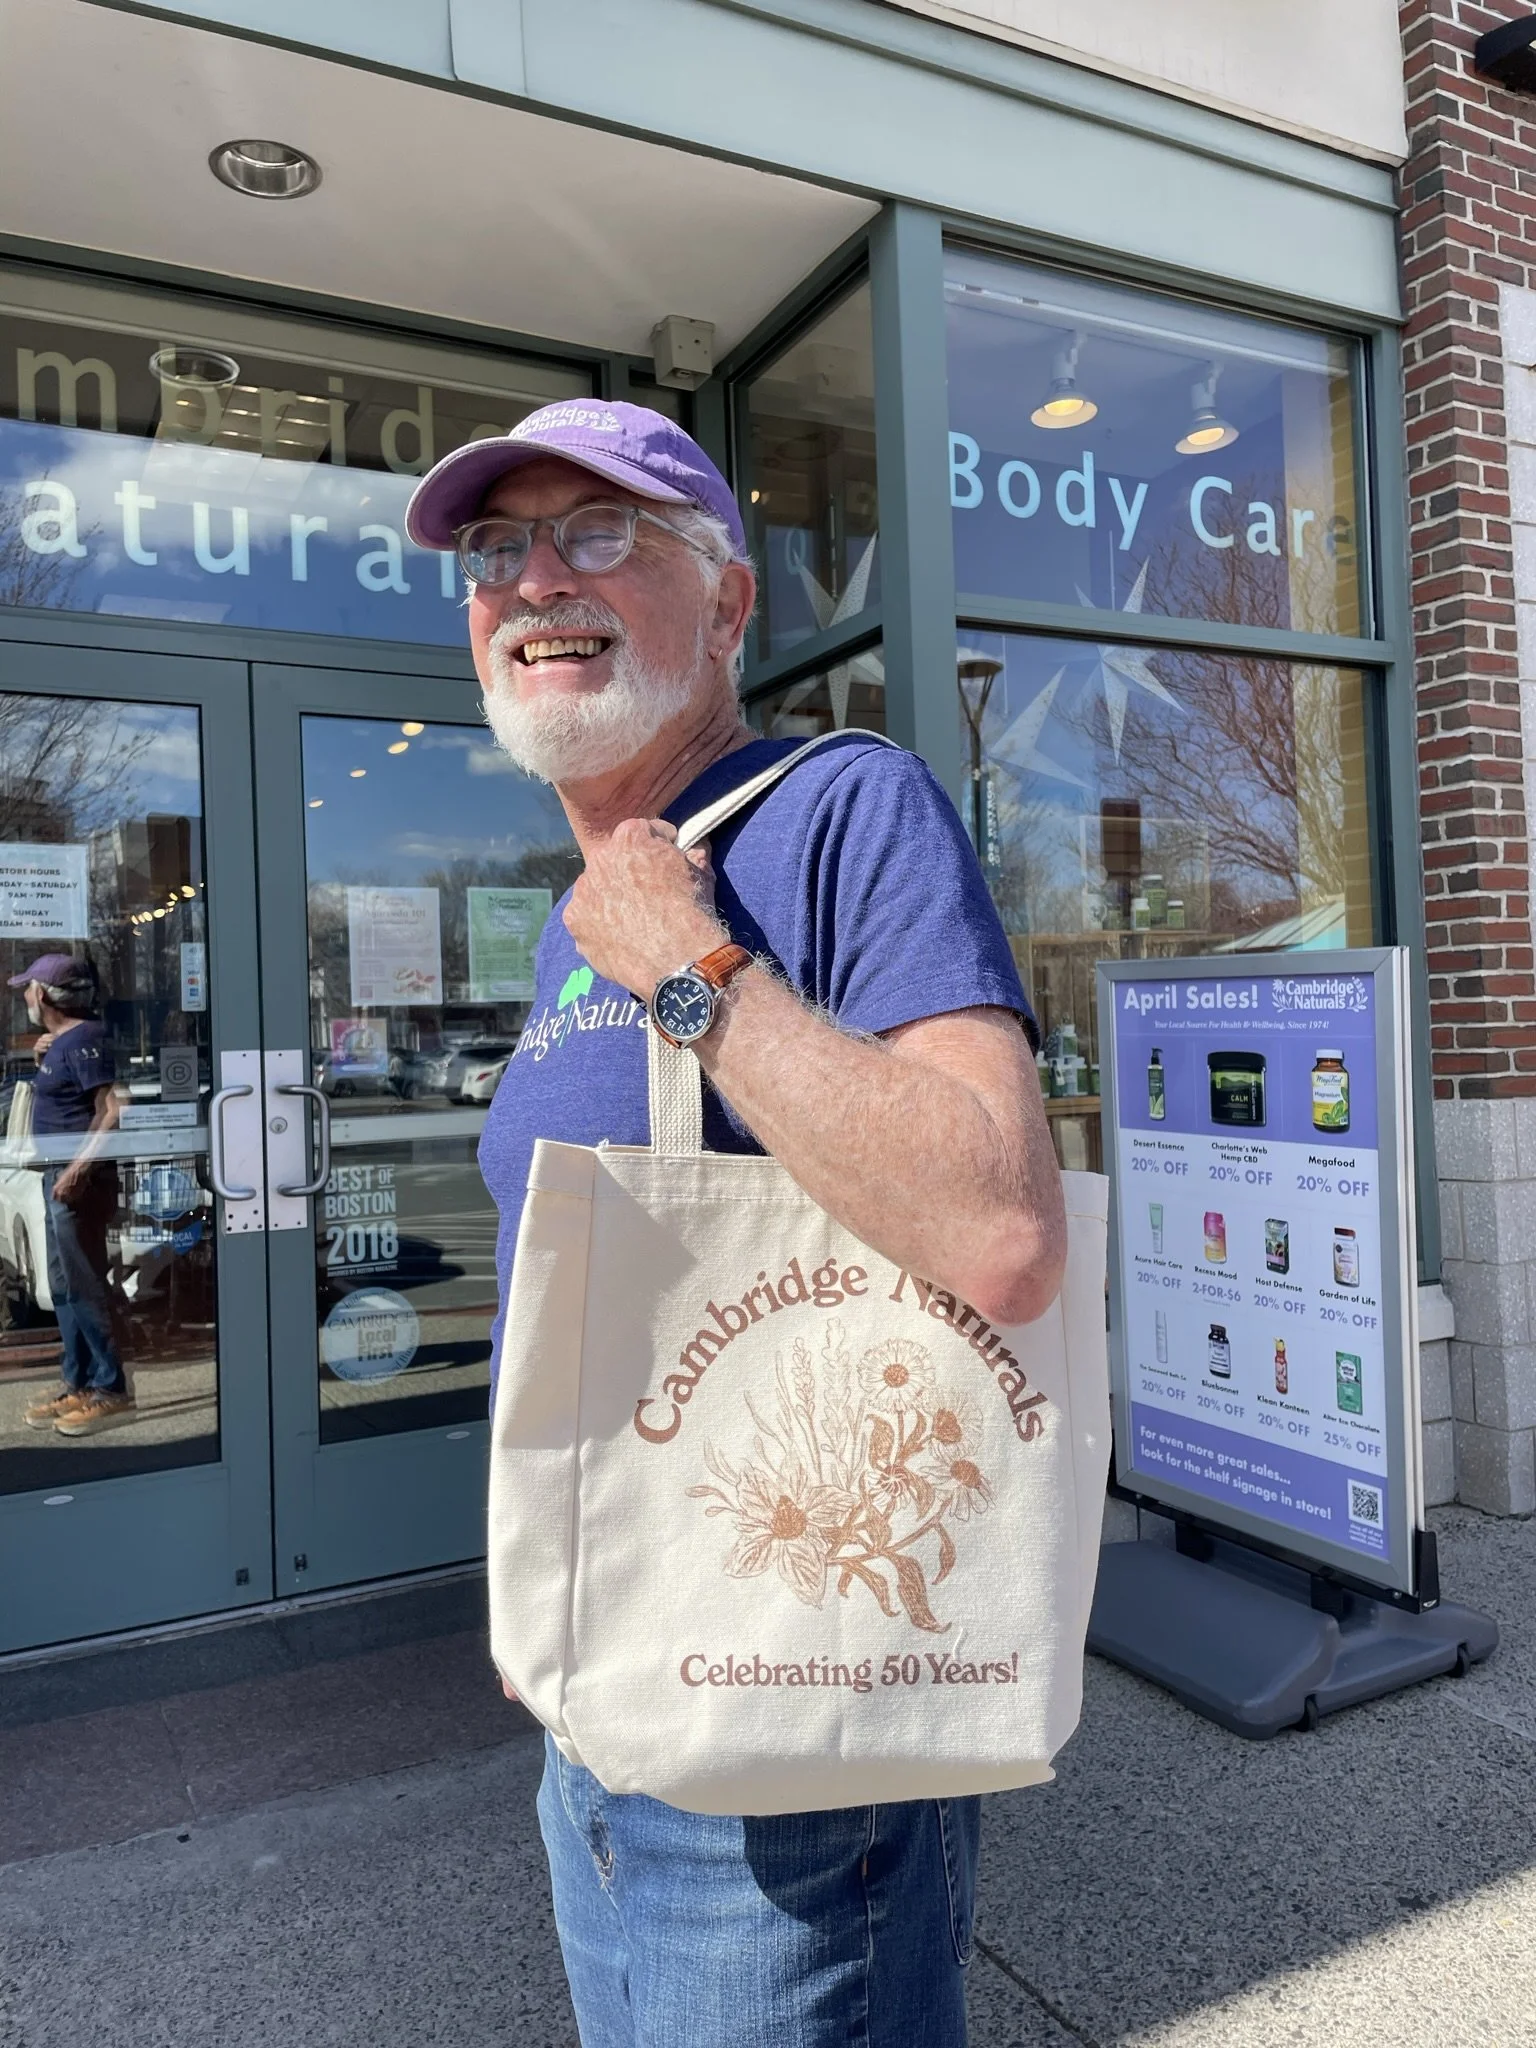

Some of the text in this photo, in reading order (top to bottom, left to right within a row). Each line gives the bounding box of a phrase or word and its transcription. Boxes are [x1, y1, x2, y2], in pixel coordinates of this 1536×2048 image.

[948, 431, 1149, 551] Body
[30, 868, 61, 876] HOURS
[13, 909, 49, 917] SUNDAY
[1285, 978, 1354, 997] Cambridge
[1123, 983, 1258, 1016] April Sales!
[1293, 994, 1346, 1010] Naturals
[1168, 1020, 1185, 1029] Local
[1186, 1020, 1207, 1029] Source
[1208, 1020, 1220, 1029] For
[1220, 1020, 1242, 1029] Health
[1287, 1020, 1307, 1029] Since
[1308, 1020, 1330, 1029] 1974!
[1230, 1094, 1249, 1102] CALM
[1133, 1139, 1185, 1152] Desert Essence
[1251, 1146, 1268, 1155] Web
[1131, 1157, 1189, 1176] 20% OFF
[1220, 1153, 1258, 1164] Hemp CBD
[1308, 1155, 1355, 1168] Megafood
[324, 1165, 395, 1194] BEST OF
[1208, 1165, 1273, 1186] 20% OFF
[1296, 1175, 1370, 1197] 20% OFF
[325, 1190, 397, 1218] BOSTON
[326, 1220, 399, 1265] 2018
[1153, 1258, 1167, 1266] Hair
[1168, 1260, 1183, 1270] Care
[1194, 1265, 1238, 1280] Recess Mood
[1136, 1271, 1182, 1289] 20% OFF
[1255, 1277, 1303, 1293] Host Defense
[1192, 1282, 1242, 1302] 2-FOR-$6
[1319, 1288, 1377, 1306] Garden of Life
[1253, 1294, 1307, 1315] 20% OFF
[327, 1310, 417, 1330] CAMBRIDGE
[1319, 1307, 1378, 1329] 20% OFF
[357, 1325, 397, 1343] Local
[357, 1344, 393, 1362] First
[633, 1256, 1049, 1445] Cambridge Naturals
[1141, 1379, 1187, 1401] 20% OFF
[1201, 1379, 1239, 1396] Bluebonnet
[1197, 1395, 1245, 1418] 20% OFF
[1257, 1394, 1310, 1415] Klean Kanteen
[1258, 1412, 1311, 1437] 20% OFF
[1350, 1420, 1381, 1434] Chocolate
[1323, 1431, 1382, 1458] 25% OFF
[1140, 1425, 1291, 1485] For even more great sales...
[1140, 1443, 1332, 1521] look for the shelf signage in store!
[679, 1651, 1019, 1694] Celebrating 50 Years!
